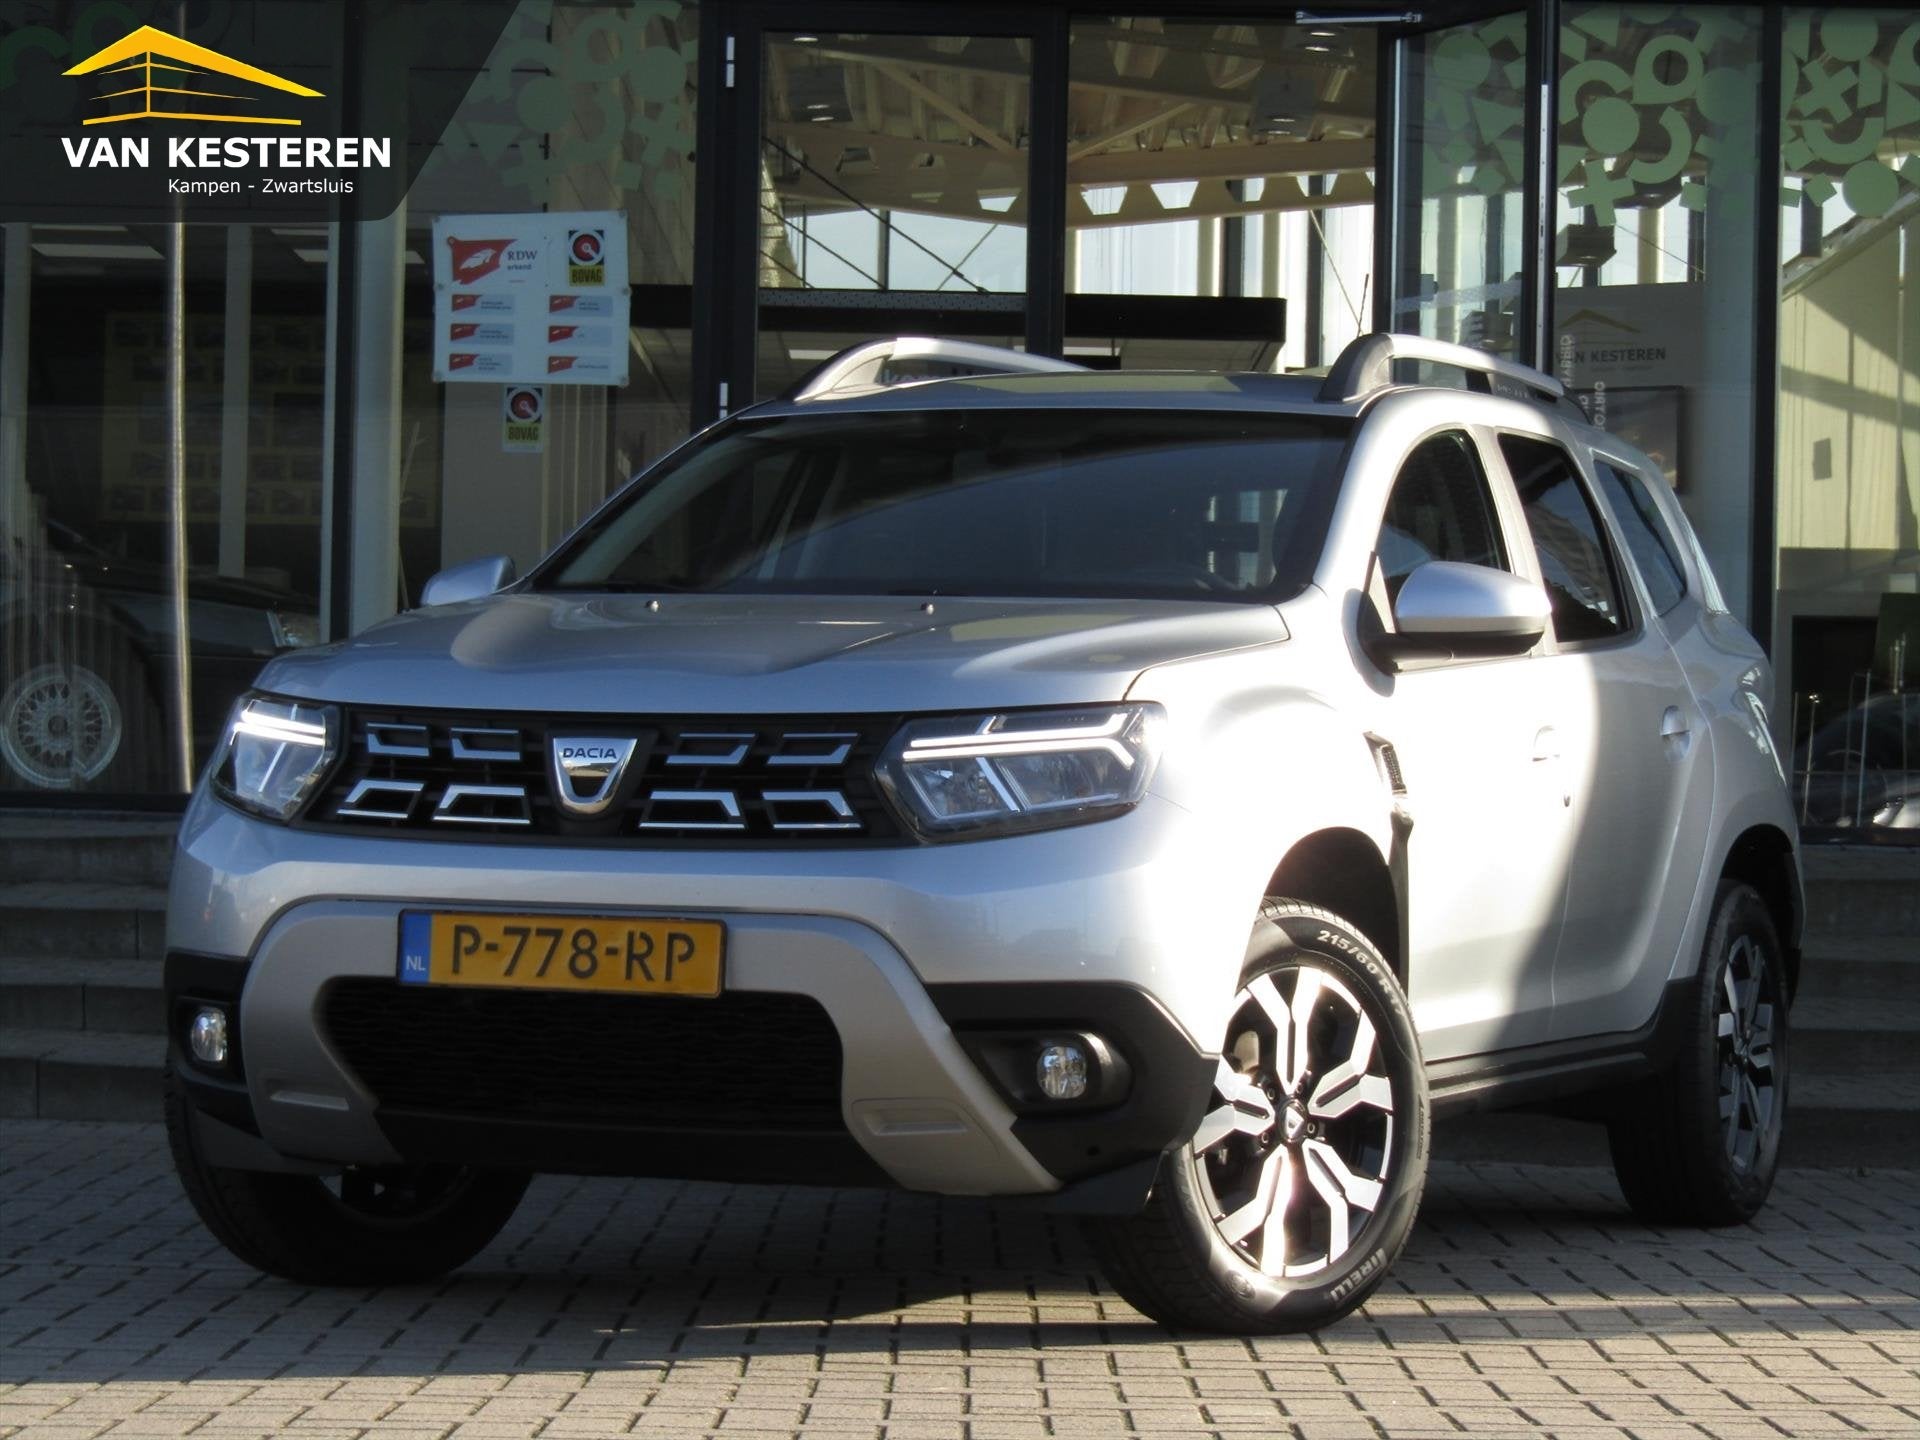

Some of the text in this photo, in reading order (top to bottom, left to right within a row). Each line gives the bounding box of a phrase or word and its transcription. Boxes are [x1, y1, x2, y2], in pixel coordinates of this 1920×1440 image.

[507, 250, 538, 261] RDW
[571, 268, 603, 283] BOVAG
[1590, 346, 1667, 363] KESTEREN
[508, 426, 539, 441] BOVAG
[562, 747, 617, 760] DACIA
[451, 924, 696, 983] P-778-RP
[1316, 929, 1378, 975] 215/60
[405, 955, 426, 972] NL
